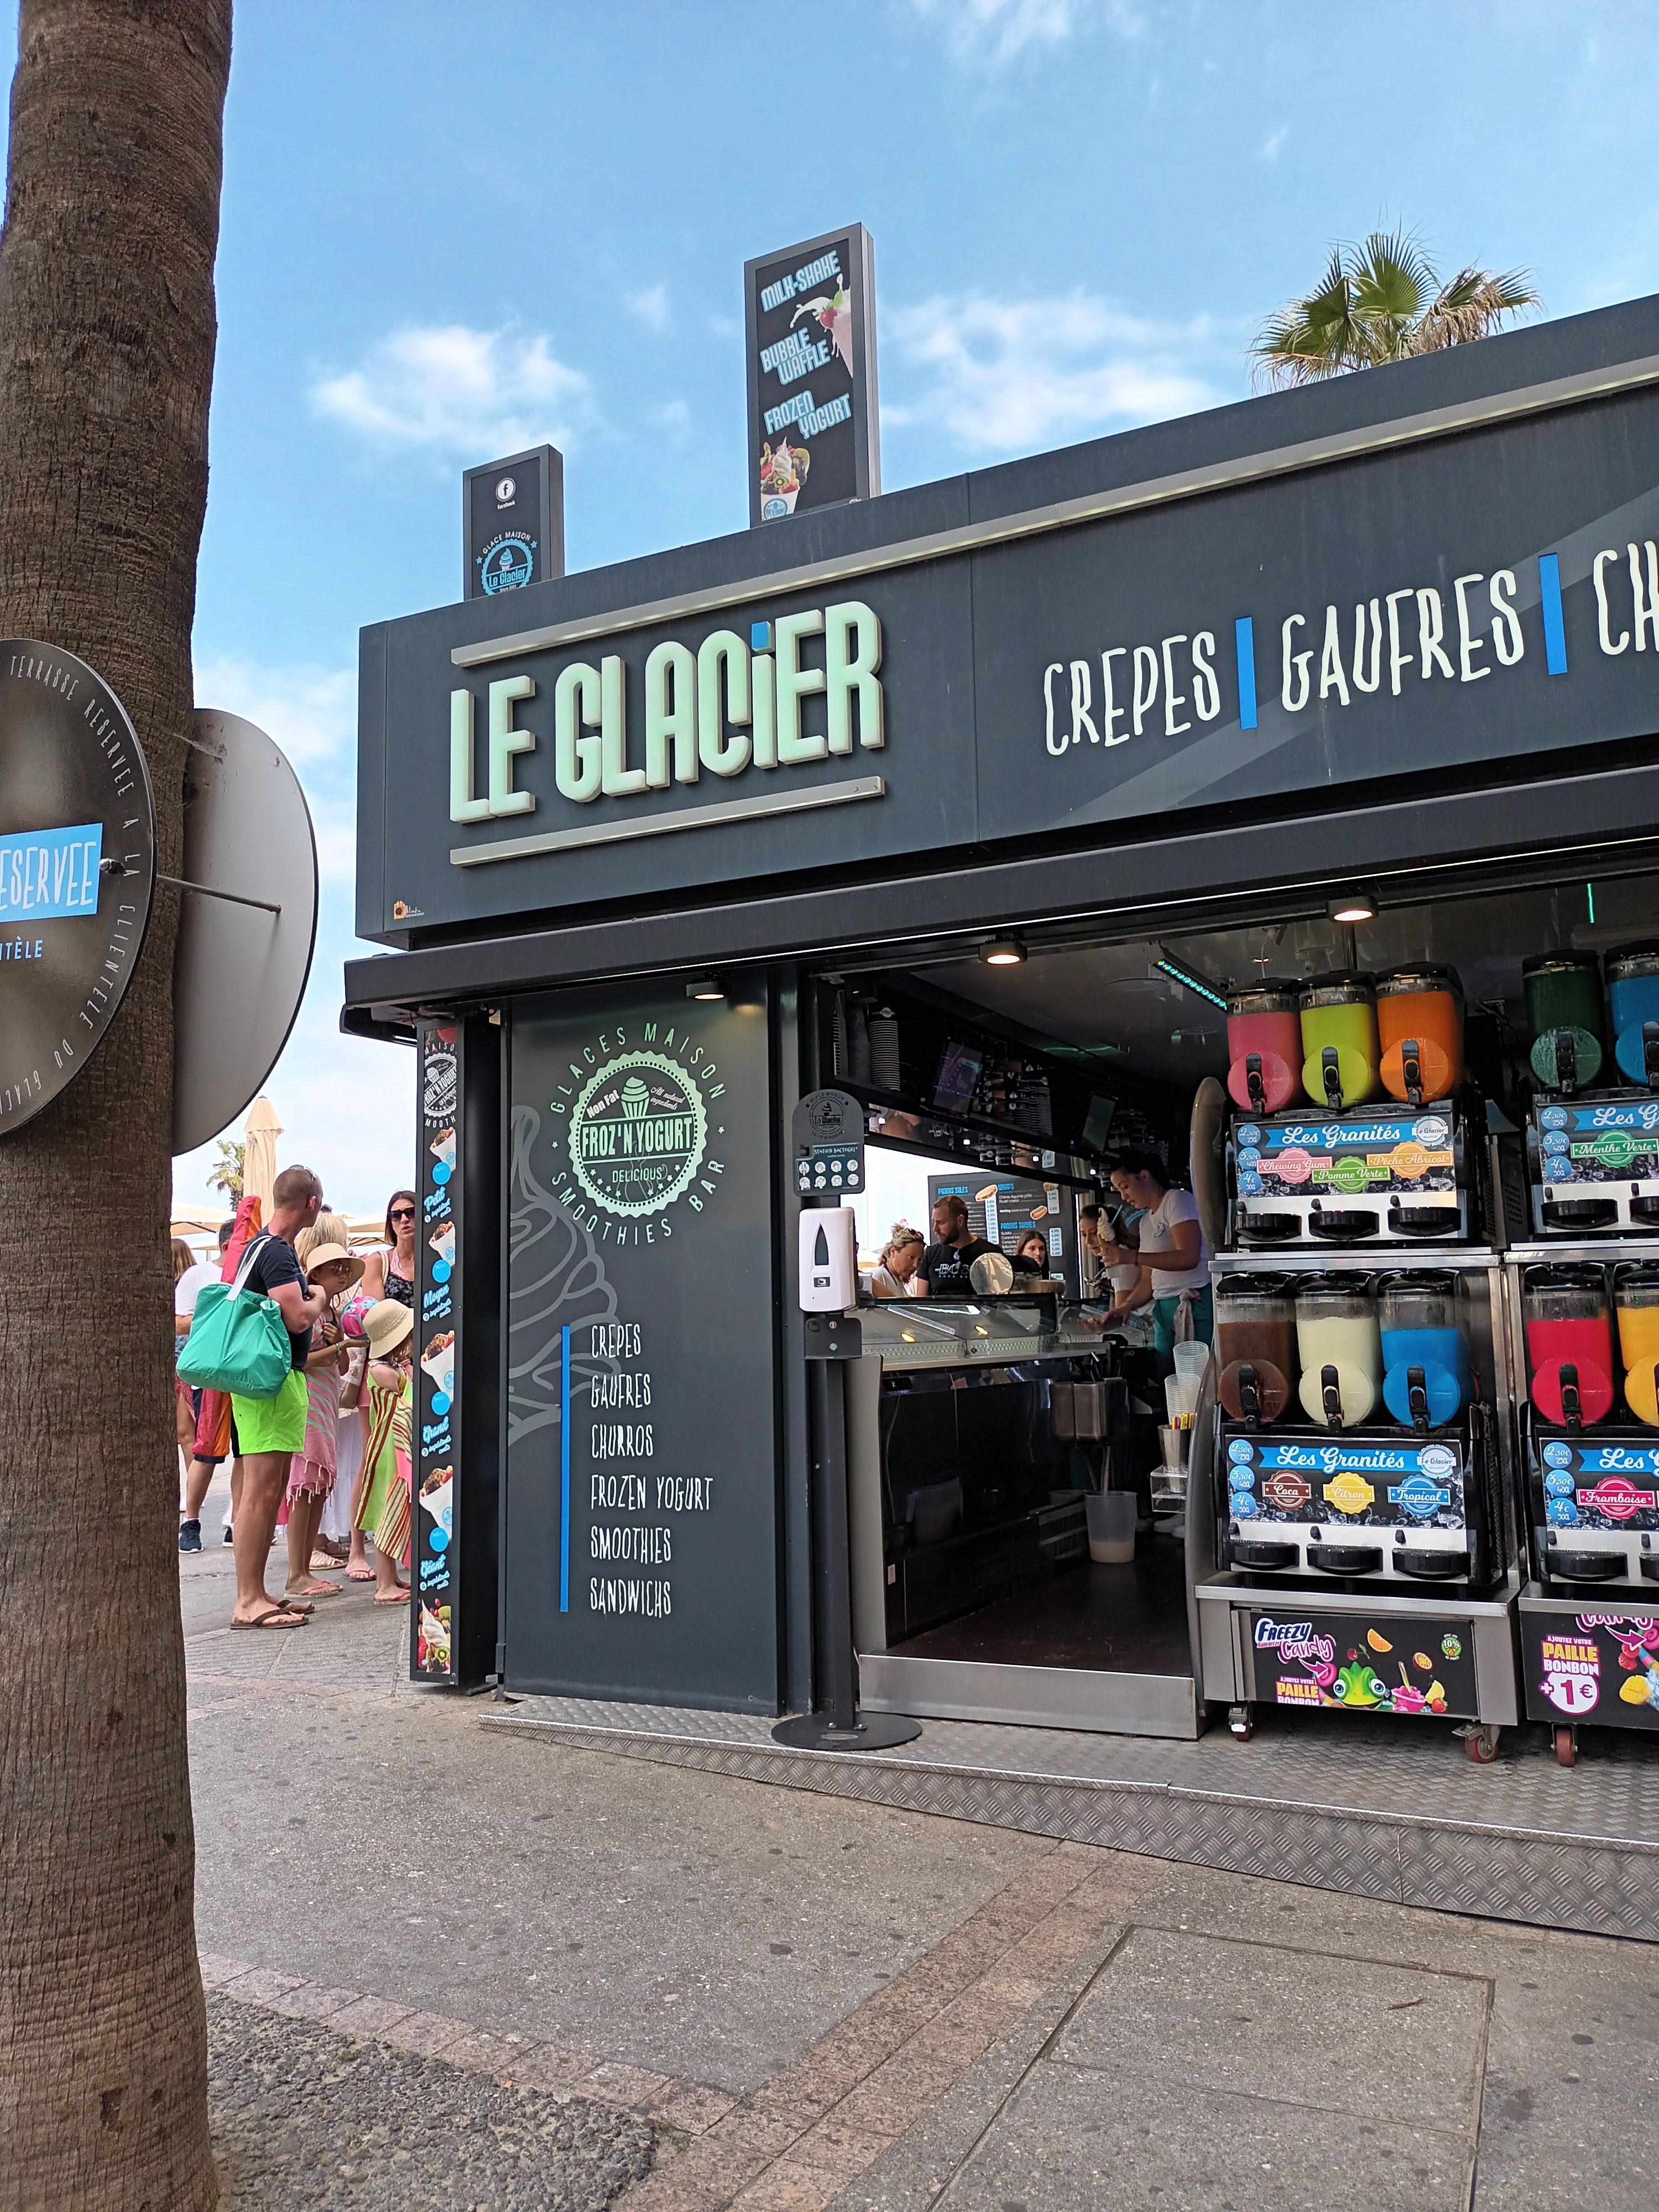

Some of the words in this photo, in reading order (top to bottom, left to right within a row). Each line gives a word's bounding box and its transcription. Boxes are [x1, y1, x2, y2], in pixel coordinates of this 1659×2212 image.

[760, 250, 841, 312] MILK-SHAKE
[760, 327, 811, 373] BUBBLE
[777, 339, 831, 385] WAFFLE
[764, 390, 814, 435] FROZEN
[797, 393, 852, 440] YOGURT
[497, 500, 515, 510] facebook
[483, 534, 502, 554] GLACE
[505, 531, 531, 541] MAISON
[489, 575, 498, 587] Le
[499, 568, 526, 584] Glacier
[1044, 631, 1220, 756] CREPES
[1282, 568, 1524, 712] GAUFRES
[11, 656, 79, 700] TERRASSE
[84, 699, 134, 796] RESERVEE
[450, 675, 535, 824] LE
[123, 818, 139, 828] A
[0, 841, 97, 910] ESERVEE
[123, 854, 140, 877] LA
[80, 905, 136, 1029] CLIENTELE
[54, 1039, 74, 1068] DU
[550, 1027, 626, 1114] GLACES
[644, 1022, 726, 1099] MAISON
[586, 1098, 606, 1119] Non
[604, 1089, 620, 1108] Fat
[650, 1096, 678, 1110] ingredients
[651, 1087, 665, 1096] All
[663, 1093, 686, 1103] natural
[1593, 1107, 1634, 1126] Les
[1638, 1104, 1659, 1130] G
[582, 1122, 633, 1157] FROZ'N
[635, 1117, 692, 1154] YOGURT
[1282, 1126, 1318, 1144] Les
[1322, 1124, 1400, 1147] Granités
[1579, 1144, 1621, 1154] Menthe
[1623, 1142, 1652, 1152] Verte
[1261, 1161, 1303, 1172] Chewing
[1304, 1160, 1327, 1171] Gum
[1374, 1155, 1406, 1166] Pêche
[1408, 1154, 1446, 1164] Abricot
[612, 1166, 662, 1183] DELICIOUS
[1318, 1170, 1355, 1181] Pomme
[1357, 1168, 1384, 1178] Verte
[424, 1186, 446, 1212] Petit
[552, 1172, 672, 1245] SMOOTHIES
[688, 1160, 726, 1213] BAR
[424, 1284, 450, 1308] Moyen
[591, 1323, 641, 1358] CREPES
[591, 1373, 651, 1408] GAUFRES
[423, 1416, 449, 1444] Grand
[591, 1423, 654, 1460] CHURROS
[1276, 1446, 1316, 1467] Les
[1319, 1446, 1405, 1472] Granités
[1599, 1448, 1644, 1469] Les
[591, 1474, 646, 1510] FROZEN
[656, 1476, 713, 1511] YOGURT
[1274, 1485, 1299, 1496] Coca
[1331, 1487, 1365, 1500] Citron
[1397, 1489, 1441, 1504] Tropical
[1585, 1491, 1647, 1504] Framboise
[591, 1525, 671, 1564] SMOOTHIES
[420, 1554, 446, 1579] Géant
[590, 1577, 671, 1619] SANDWICHS
[1543, 1642, 1598, 1662] PAILLE
[1543, 1659, 1599, 1676] BONBON
[1277, 1682, 1319, 1698] PAILLE
[1277, 1696, 1319, 1705] BONBON
